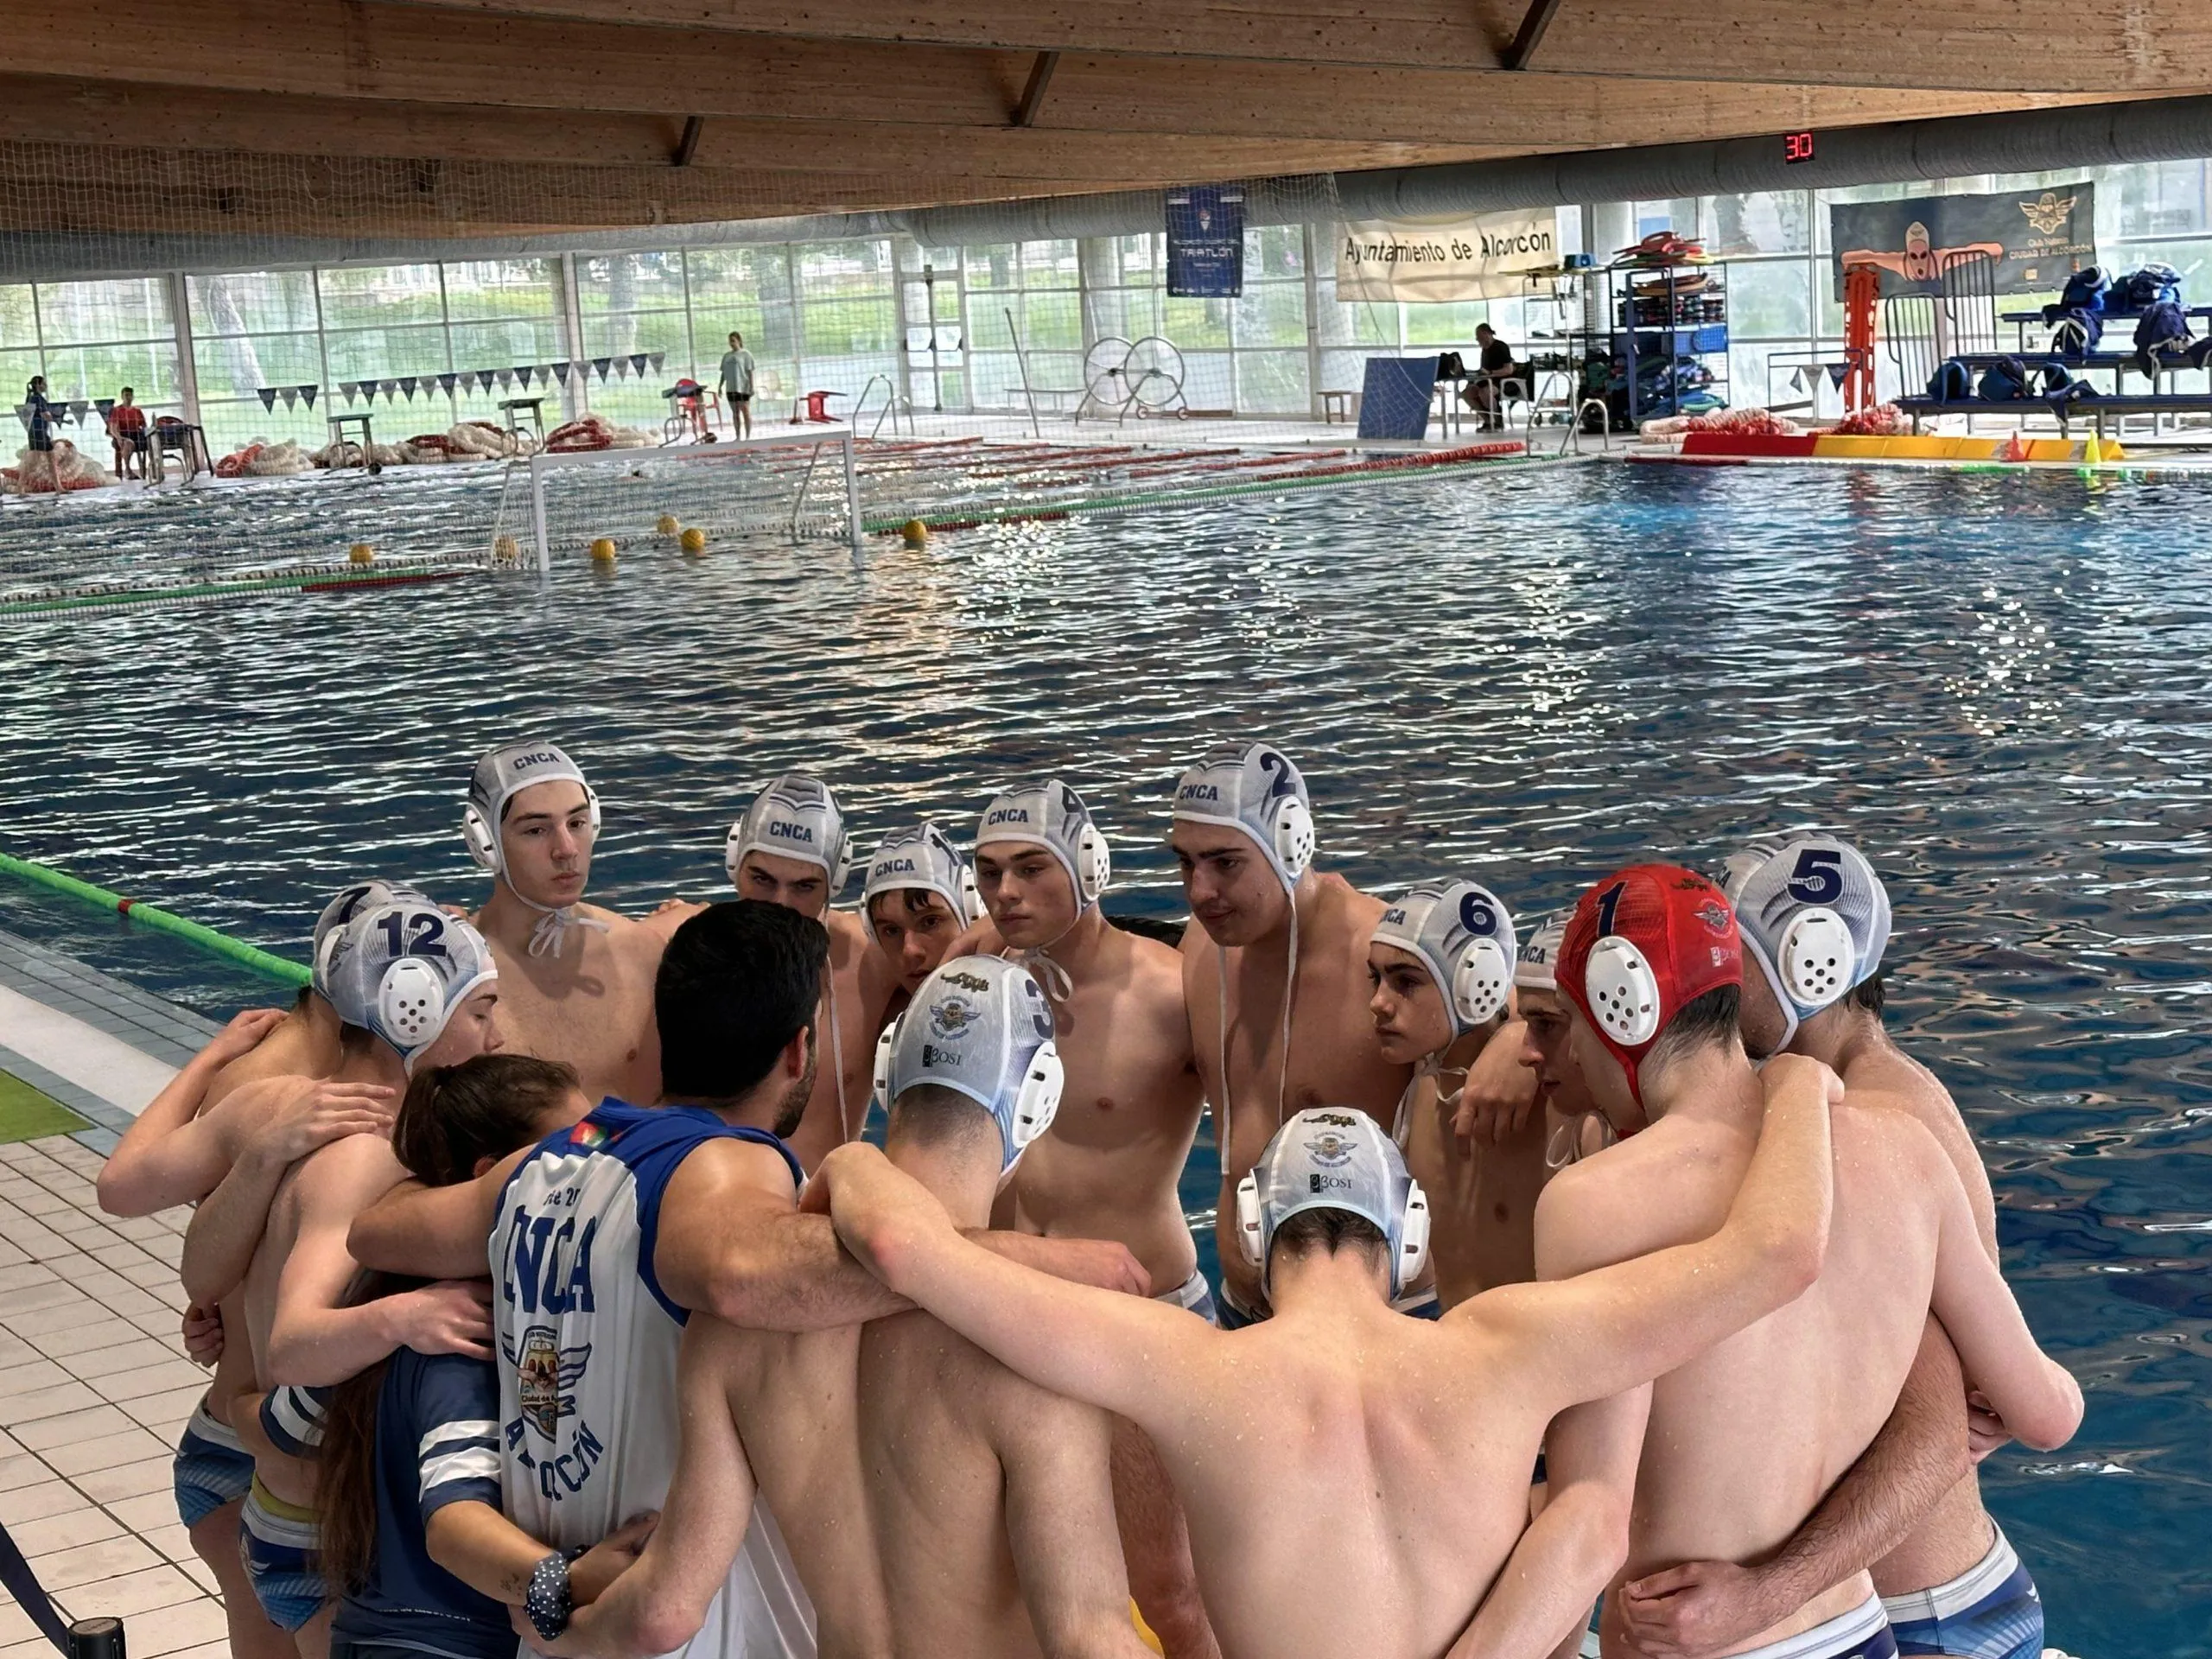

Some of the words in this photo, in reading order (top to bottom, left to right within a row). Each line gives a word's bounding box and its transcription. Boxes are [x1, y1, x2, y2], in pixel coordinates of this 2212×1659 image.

[1786, 133, 1812, 160] 30
[1344, 237, 1446, 264] Ayuntamiento
[1452, 238, 1472, 260] de
[1480, 222, 1551, 259] Alcorcón
[512, 753, 560, 770] CNCA
[1260, 752, 1296, 798] 2
[1062, 786, 1089, 823] 4
[1179, 784, 1218, 801] CNCA
[770, 821, 813, 843] CNCA
[988, 808, 1028, 825] CNCA
[874, 858, 916, 876] CNCA
[1787, 849, 1843, 905] 5
[338, 887, 372, 925] 7
[1459, 892, 1497, 936] 6
[1597, 880, 1627, 938] 1
[378, 911, 447, 957] 12
[1025, 979, 1054, 1040] 3
